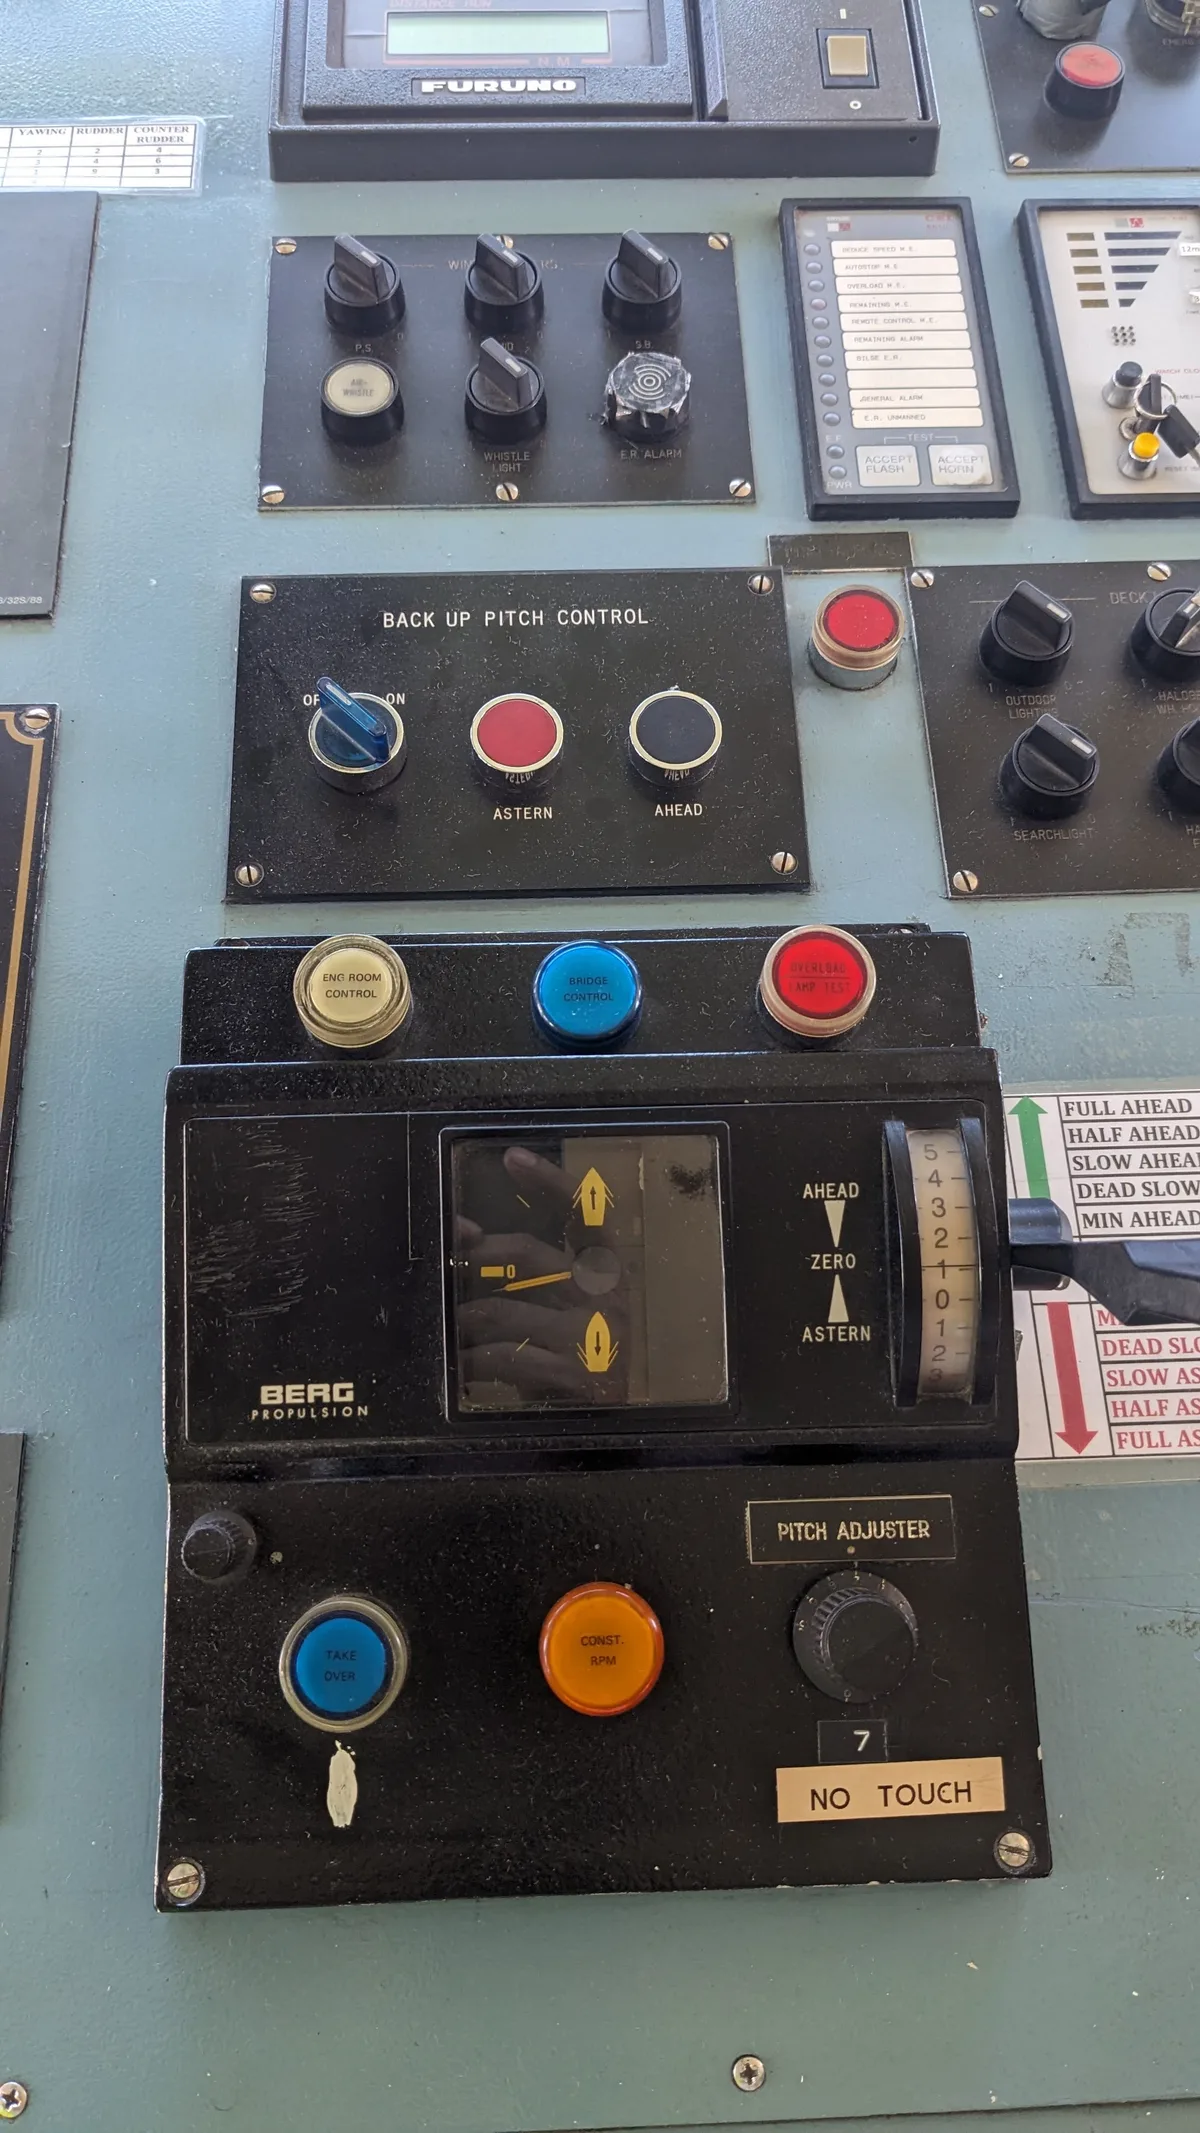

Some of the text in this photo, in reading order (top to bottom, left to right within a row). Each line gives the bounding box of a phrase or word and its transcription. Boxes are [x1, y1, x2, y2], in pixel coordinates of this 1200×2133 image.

[421, 80, 577, 93] FURUNO
[19, 125, 190, 136] YAWING RUDDER COUNTER
[908, 433, 934, 441] TEST
[484, 451, 531, 461] WHISTLE
[644, 449, 682, 459] ALARM
[865, 455, 913, 464] ACCEPT
[938, 455, 984, 464] ACCEPT
[866, 465, 905, 473] FLASH
[939, 465, 974, 474] HORN
[827, 481, 852, 489] PWR
[1109, 591, 1149, 604] DECK
[383, 608, 649, 628] BACK UP PITCH CONTROL
[386, 693, 405, 705] ON
[1005, 694, 1057, 706] OUTDOOR
[493, 806, 553, 821] ASTERN
[655, 803, 703, 817] AHEAD
[1014, 827, 1094, 841] SEARCHLIGHT
[790, 961, 847, 973] OVERLOAD
[323, 973, 382, 982] ENG ROOM
[569, 977, 609, 985] BRIDGE
[325, 989, 377, 998] CONTROL
[824, 981, 851, 993] TEST
[564, 992, 614, 1002] CONTROL
[1064, 1098, 1193, 1117] FULL AHEAD
[1067, 1124, 1200, 1144] HALF AHEAD
[924, 1143, 938, 1161] 5
[1073, 1153, 1132, 1171] SLOW
[927, 1168, 943, 1188] 4
[803, 1182, 859, 1199] AHEAD
[1077, 1180, 1200, 1199] DEAD SLOW
[931, 1197, 947, 1218] 3
[1081, 1209, 1200, 1229] MIN AHEAD
[934, 1227, 949, 1249] 2
[811, 1253, 856, 1270] ZERO
[938, 1258, 946, 1279] 1
[506, 1264, 516, 1279] 0
[935, 1295, 950, 1310] 0
[802, 1325, 871, 1343] ASTERN
[936, 1319, 945, 1337] 1
[931, 1344, 947, 1362] 2
[1101, 1338, 1162, 1357] DEAD
[930, 1368, 943, 1382] 3
[1106, 1368, 1169, 1387] SLOW
[260, 1382, 354, 1405] BERG
[251, 1405, 369, 1420] PROPULSION
[1111, 1399, 1169, 1418] HALF
[1116, 1431, 1172, 1449] FULL
[777, 1519, 931, 1541] PITCH ADJUSTER
[580, 1635, 624, 1646] CONST.
[326, 1650, 356, 1661] TAKE
[591, 1656, 616, 1666] RPM
[324, 1670, 355, 1682] OVER
[853, 1729, 870, 1751] 7
[810, 1780, 972, 1811] NO TOUCH
